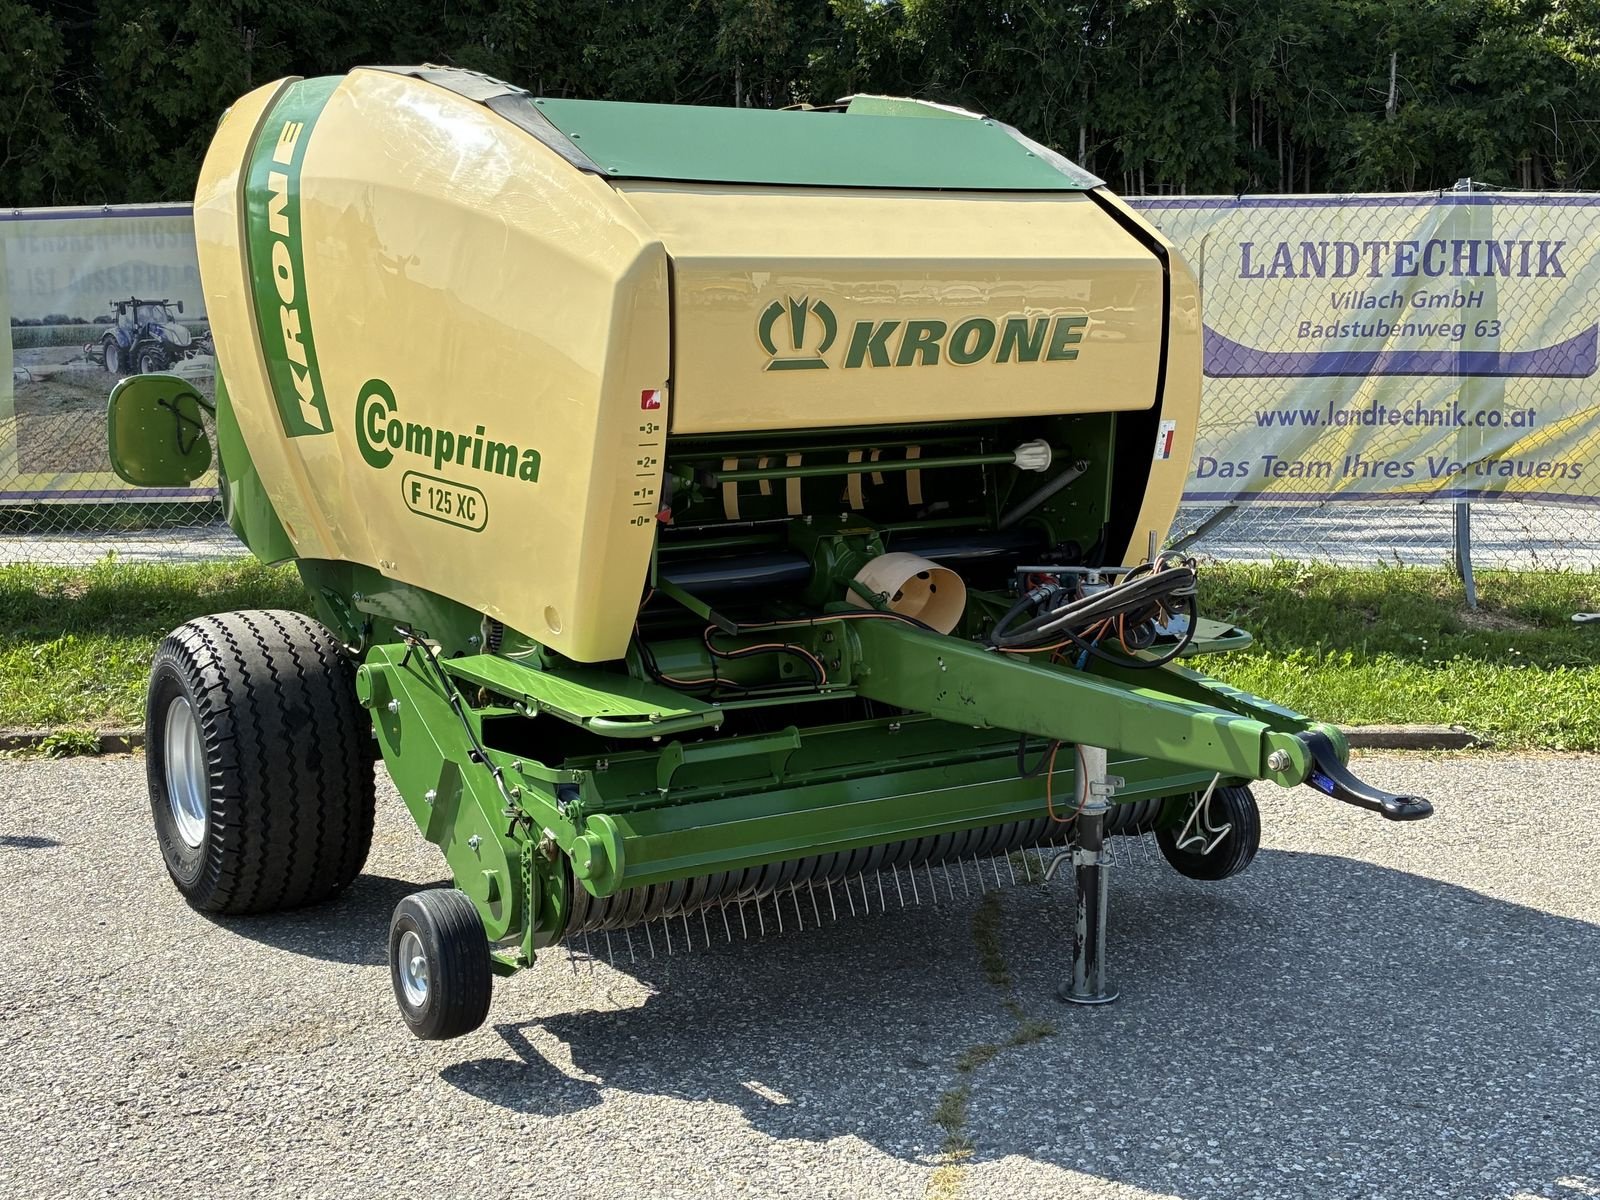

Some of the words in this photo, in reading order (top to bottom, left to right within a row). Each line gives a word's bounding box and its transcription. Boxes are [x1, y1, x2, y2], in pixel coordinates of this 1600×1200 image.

[267, 120, 325, 432] KRONE
[1238, 239, 1567, 279] LANDTECHNIK
[1330, 290, 1404, 310] Villach
[1410, 290, 1484, 309] GmbH
[842, 316, 1090, 369] KRONE
[1296, 319, 1467, 342] Badstubenweg
[1474, 319, 1502, 338] 63
[355, 378, 542, 483] Comprima
[1255, 400, 1537, 428] www.landtechnik.co.at
[1196, 456, 1250, 479] Das
[1261, 455, 1332, 478] Team
[1342, 454, 1415, 479] Ihres
[411, 481, 421, 504] F
[428, 487, 452, 514] 125
[456, 493, 476, 521] XC
